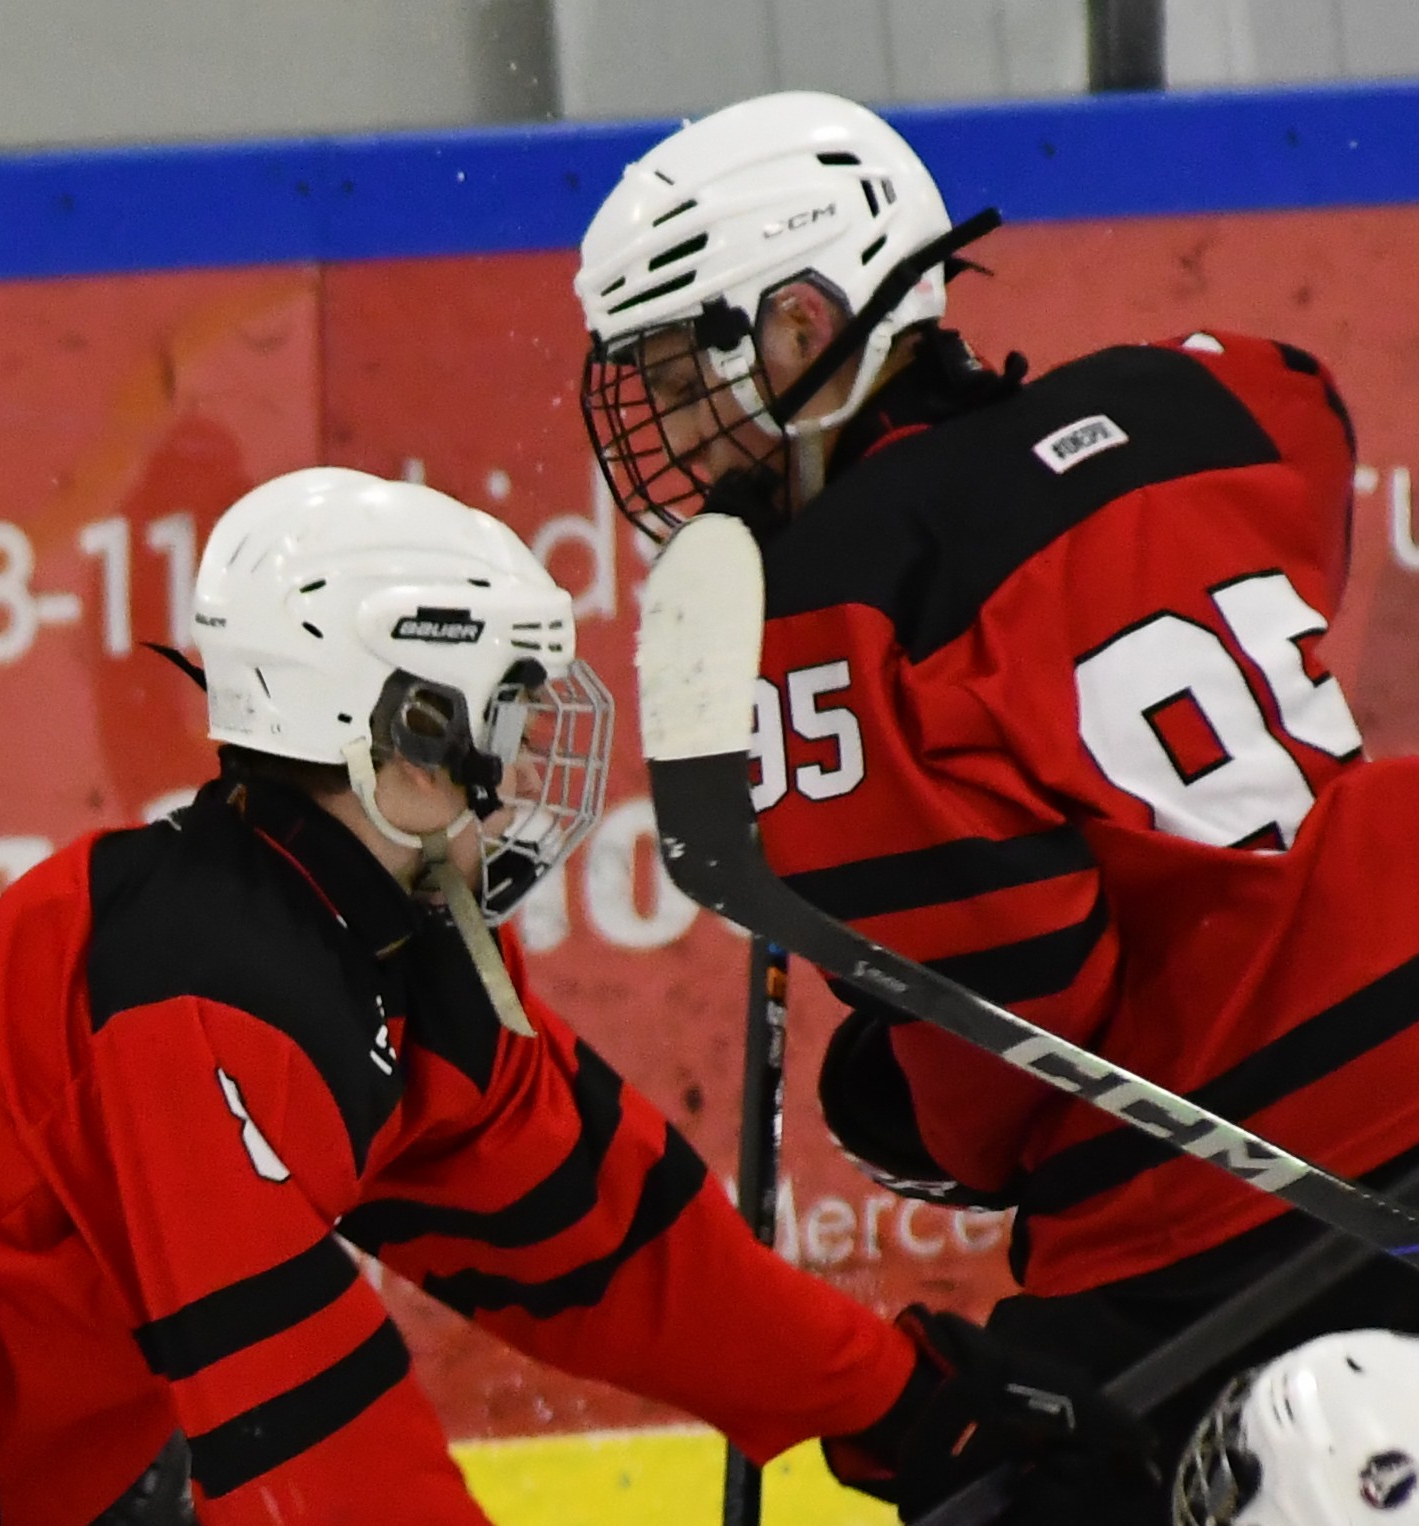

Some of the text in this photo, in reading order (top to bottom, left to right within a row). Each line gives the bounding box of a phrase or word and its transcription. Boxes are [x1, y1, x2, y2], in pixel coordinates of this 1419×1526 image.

[762, 202, 836, 239] CCM
[398, 620, 482, 642] BAUER
[1073, 566, 1364, 856] 95
[1002, 1034, 1314, 1193] CCM
